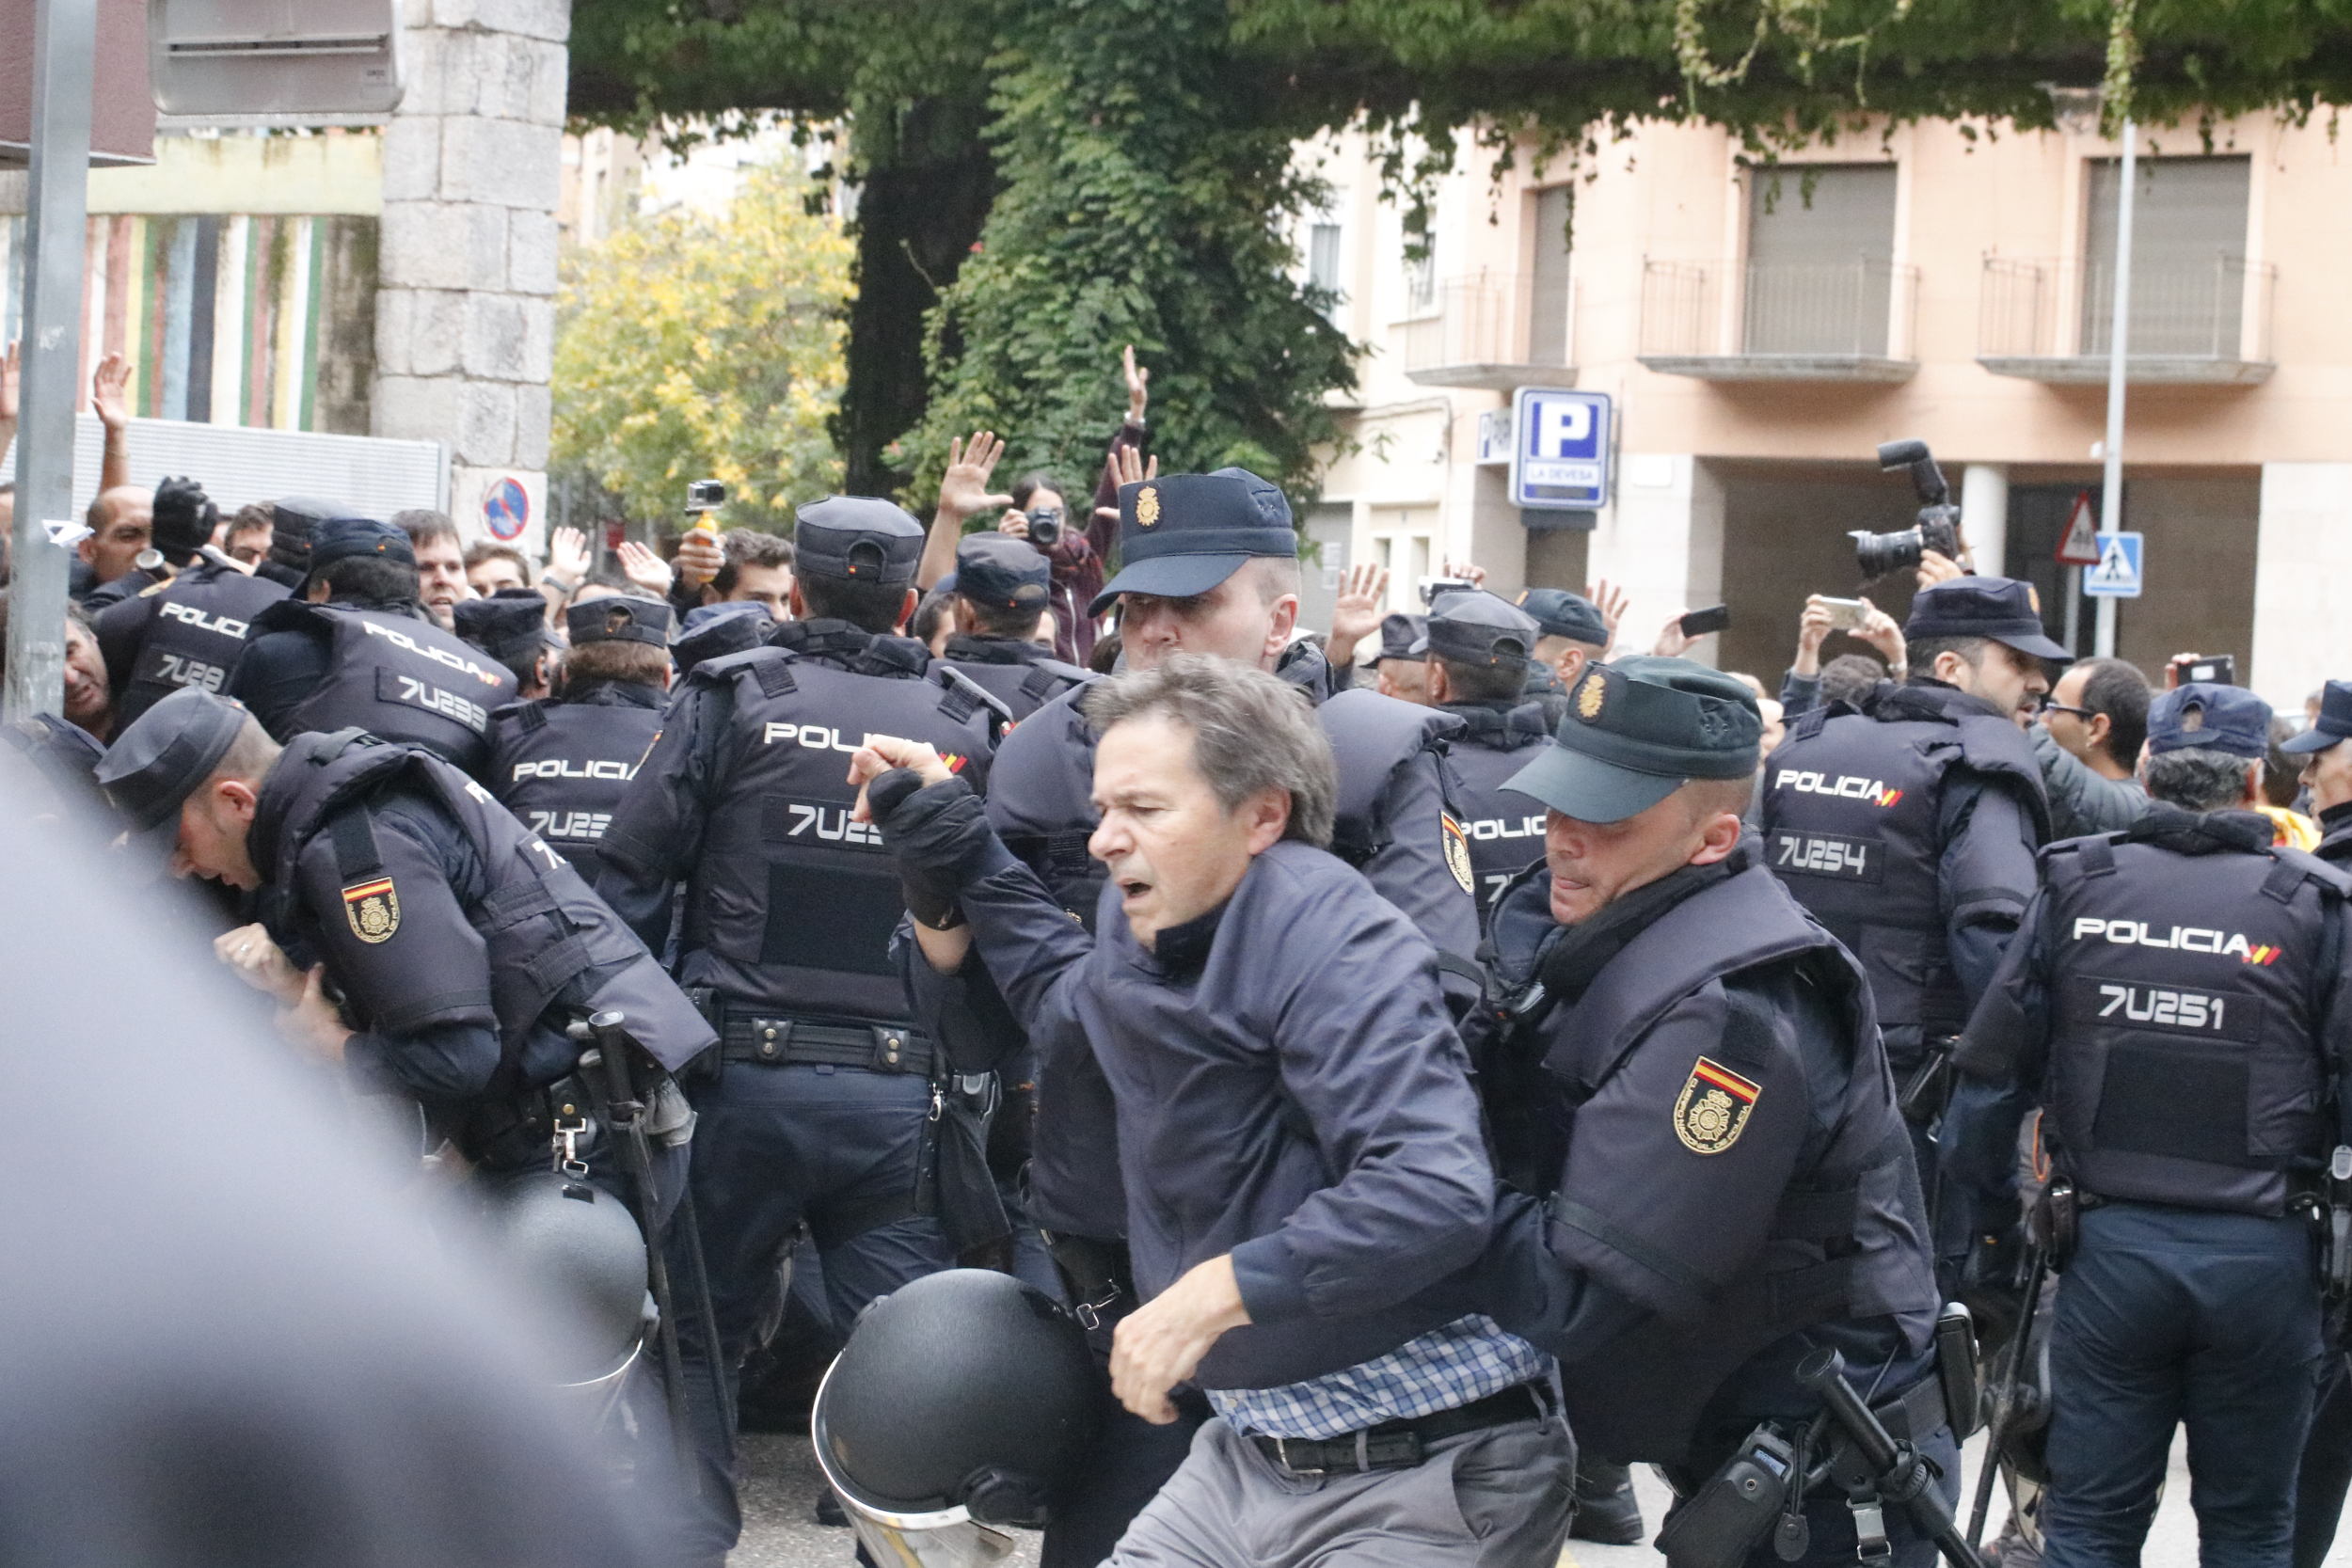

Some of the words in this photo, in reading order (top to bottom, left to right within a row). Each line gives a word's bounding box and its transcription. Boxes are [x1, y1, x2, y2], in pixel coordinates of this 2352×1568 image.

[1537, 403, 1591, 457] P
[159, 601, 250, 640] POLICI
[362, 621, 485, 679] POLICIA
[1775, 769, 1884, 801] POLICIA
[1777, 836, 1866, 875] 7U254
[2074, 917, 2251, 958] POLICIA
[2098, 985, 2224, 1030] 7U251
